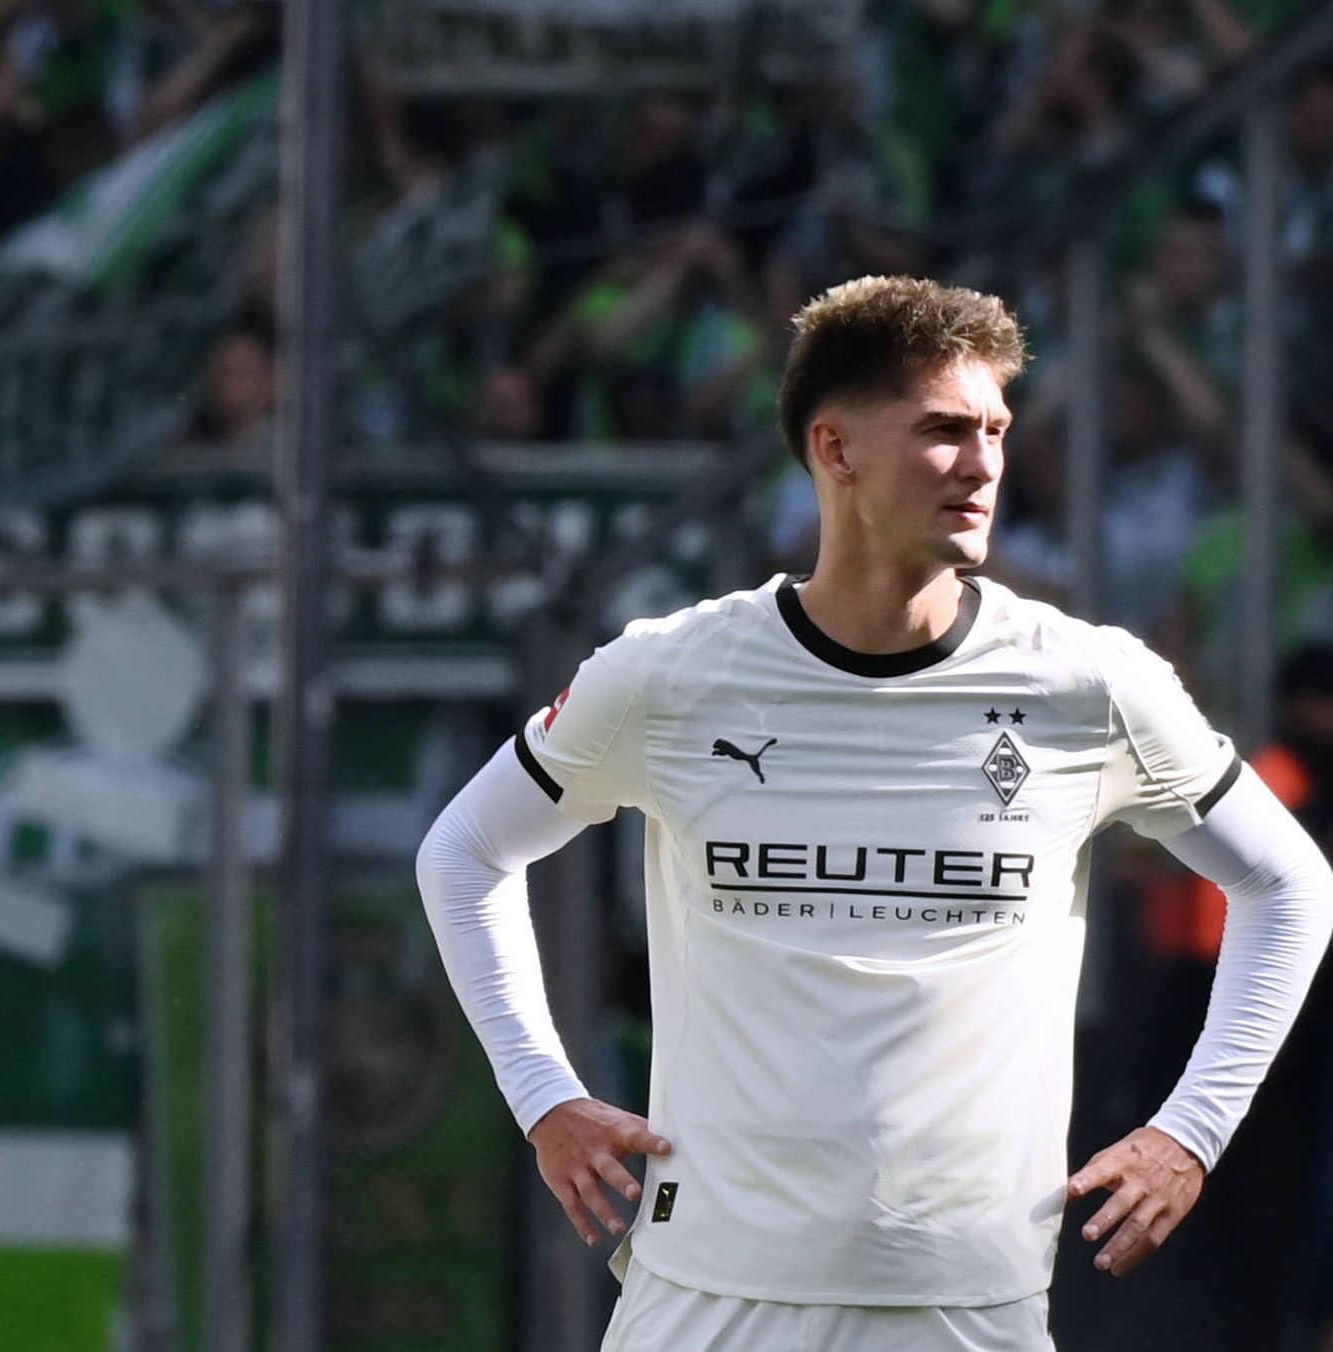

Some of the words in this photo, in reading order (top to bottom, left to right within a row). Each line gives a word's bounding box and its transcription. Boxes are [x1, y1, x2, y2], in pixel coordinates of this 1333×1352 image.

[706, 841, 1035, 888] REUTER
[713, 898, 815, 918] BÄDER
[849, 904, 1026, 924] LEUCHTEN
